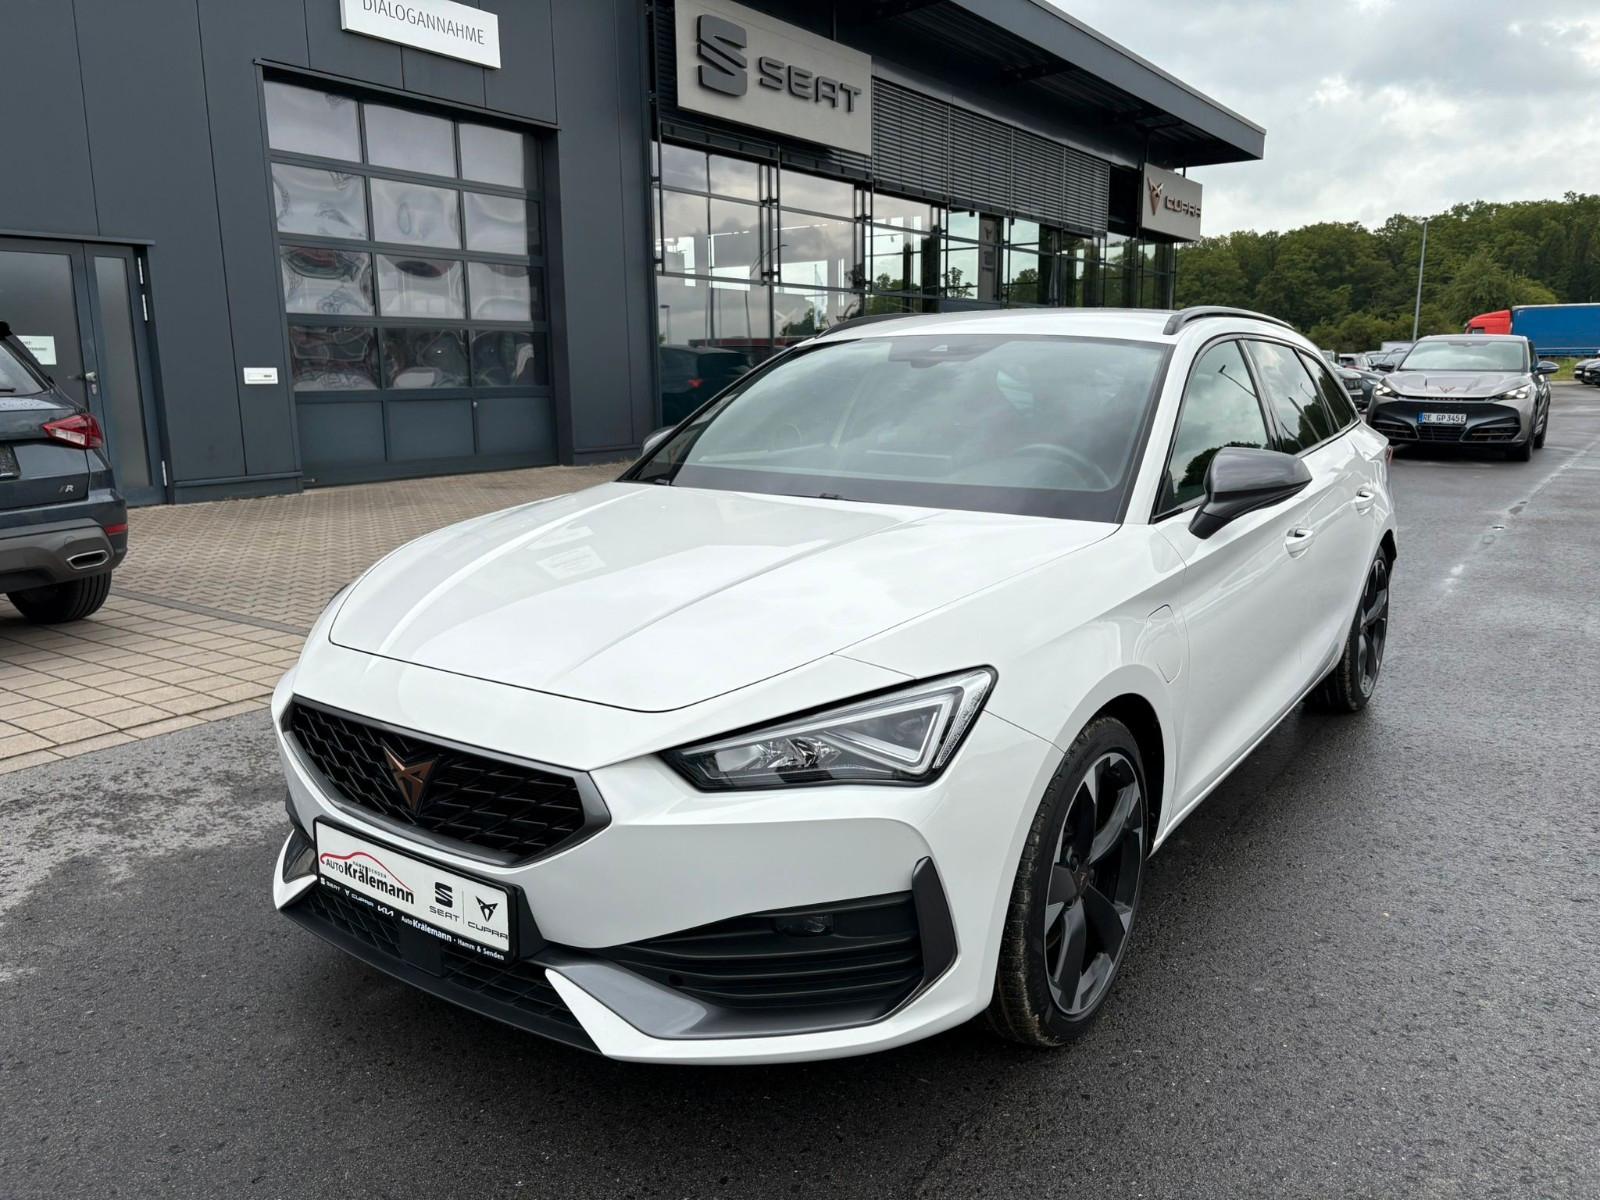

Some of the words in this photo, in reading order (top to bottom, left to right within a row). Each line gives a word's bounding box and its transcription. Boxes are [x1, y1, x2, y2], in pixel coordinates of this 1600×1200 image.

[362, 0, 485, 45] DIALOGANNAHME
[759, 56, 862, 113] SEAT
[429, 905, 460, 922] SEAT
[467, 921, 510, 940] CUPRA
[482, 947, 505, 961] Senden
